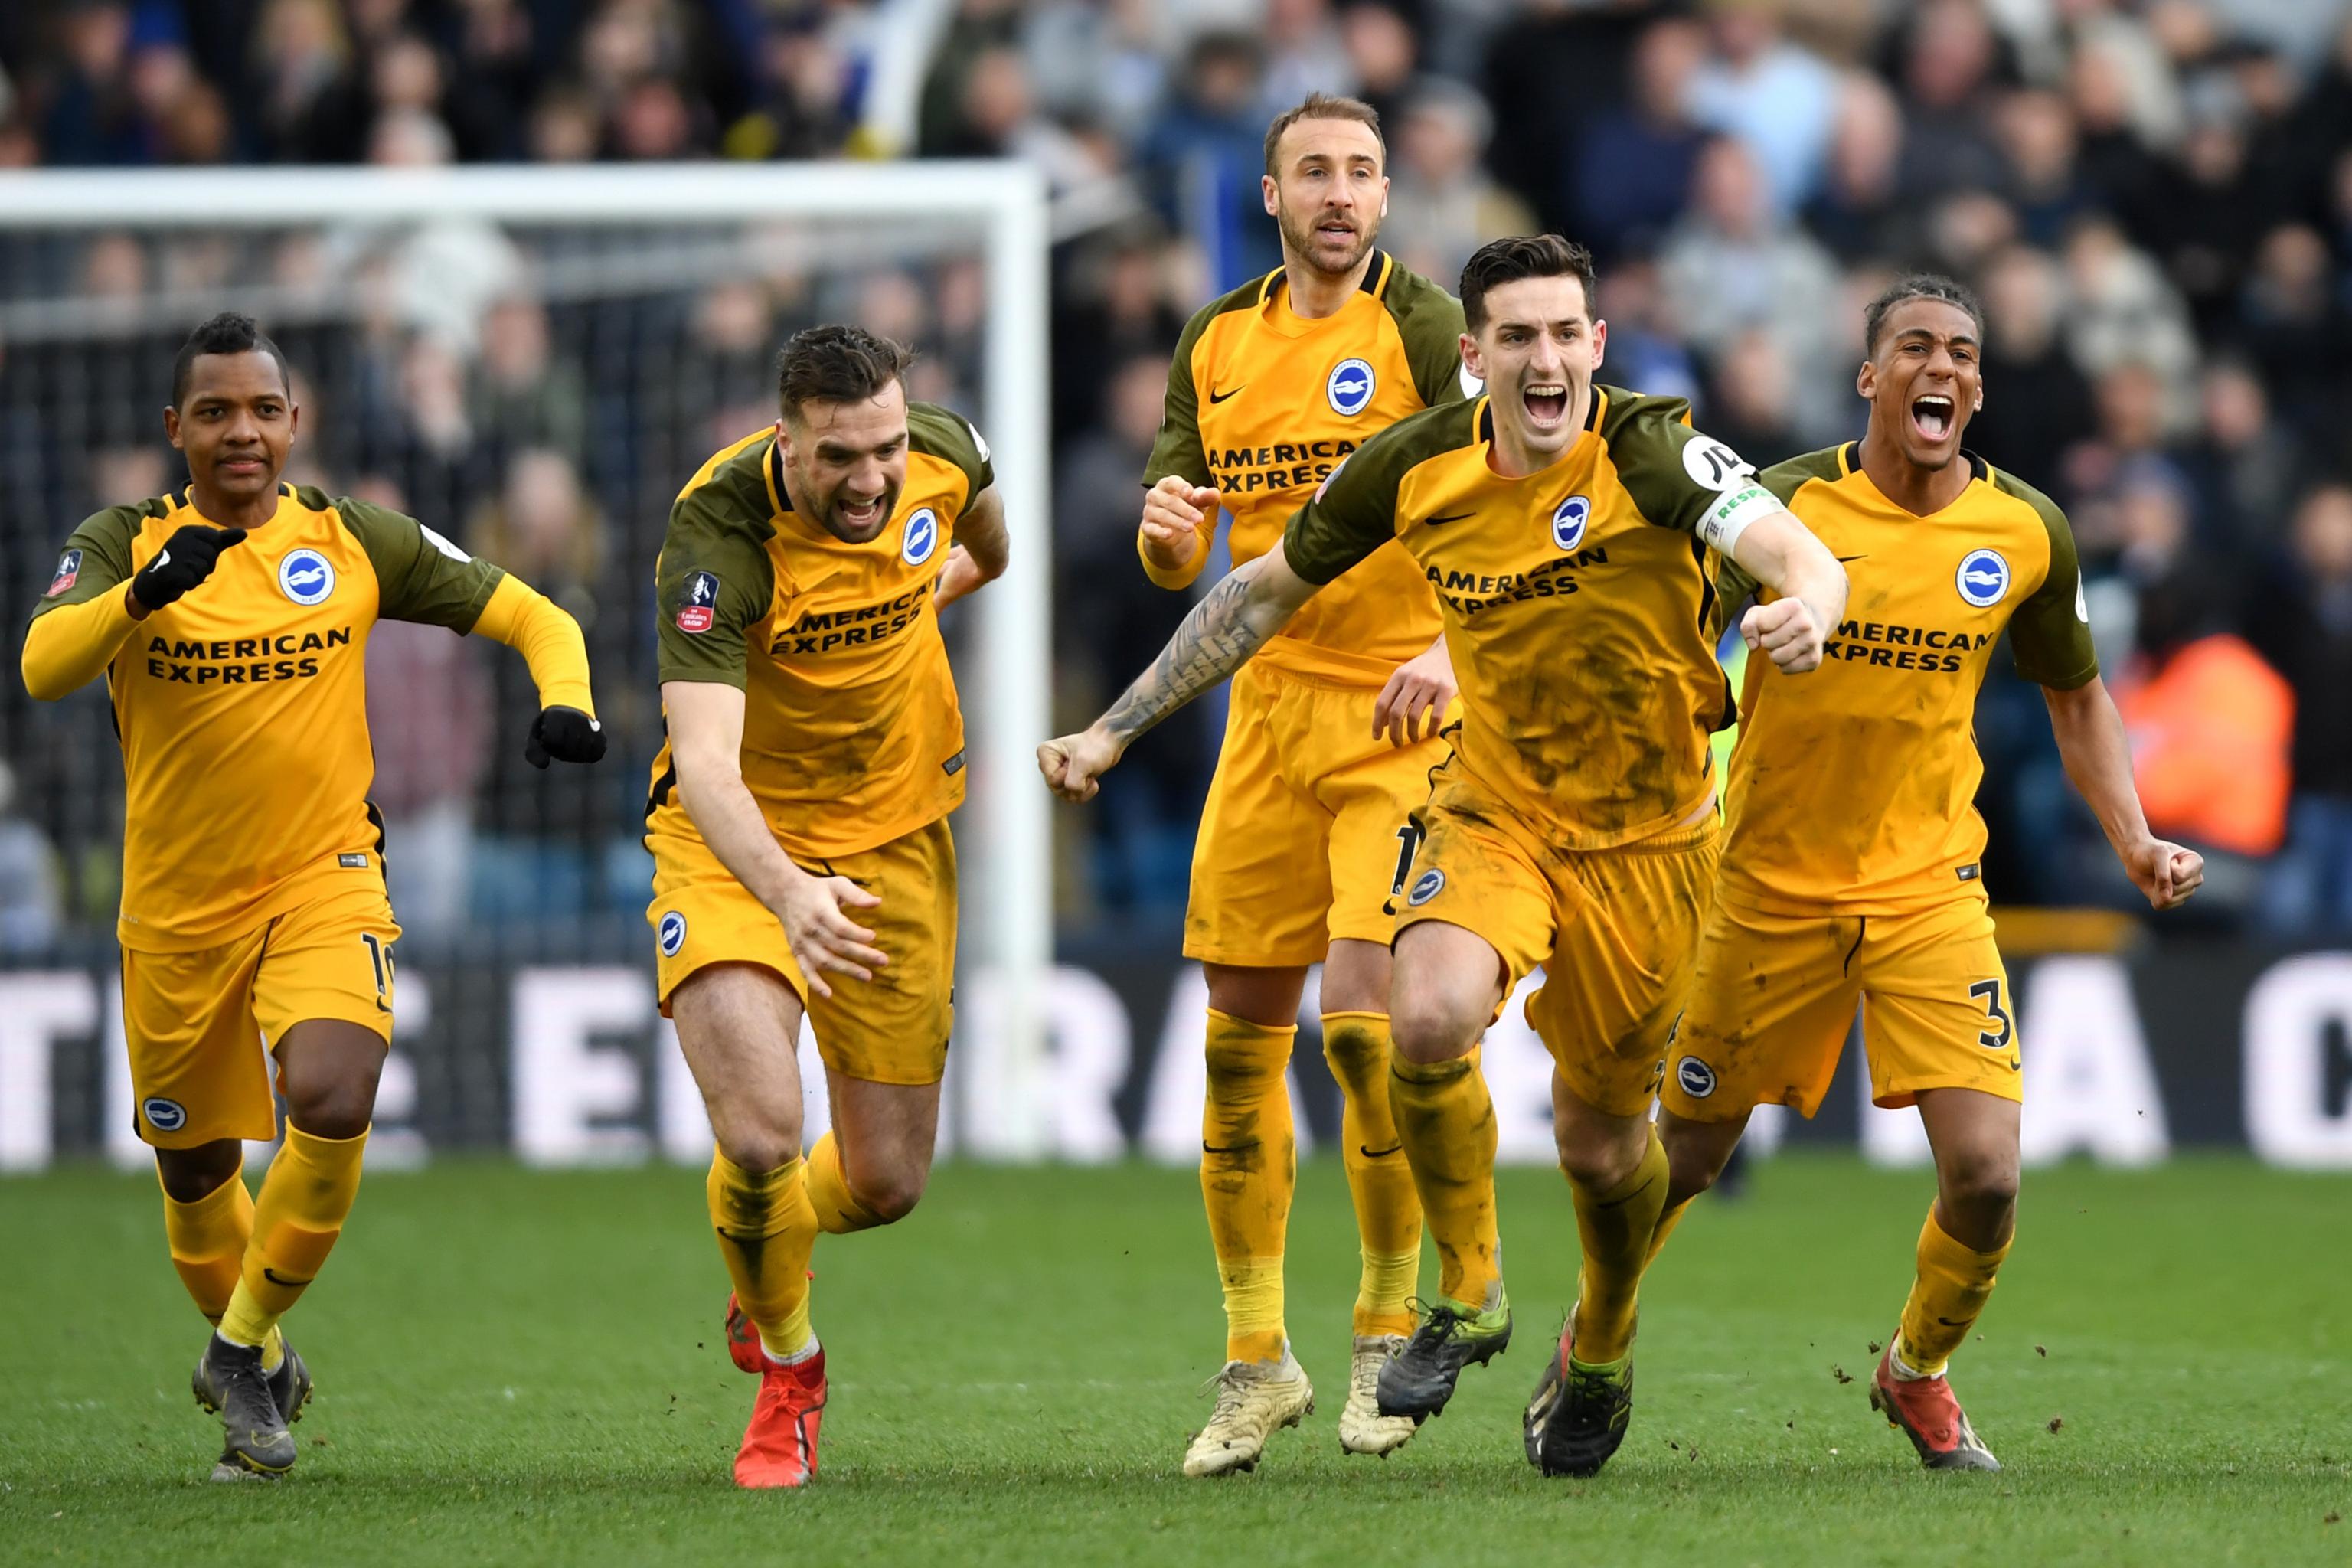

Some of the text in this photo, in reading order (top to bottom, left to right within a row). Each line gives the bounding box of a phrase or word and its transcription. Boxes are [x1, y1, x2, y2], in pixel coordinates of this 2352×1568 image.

[1208, 439, 1369, 469] AMERICA
[1214, 463, 1332, 494] XPRES
[1717, 488, 1782, 520] RESP
[776, 579, 933, 640] AMERICA
[1442, 576, 1579, 615] XPRESS
[148, 626, 351, 660] AMERICAN
[769, 602, 922, 655] EXPRESS
[1838, 619, 1994, 651] MERICAN
[148, 658, 319, 684] EXPRESS
[1823, 640, 1962, 672] XPRESS
[1968, 978, 2014, 1049] 3
